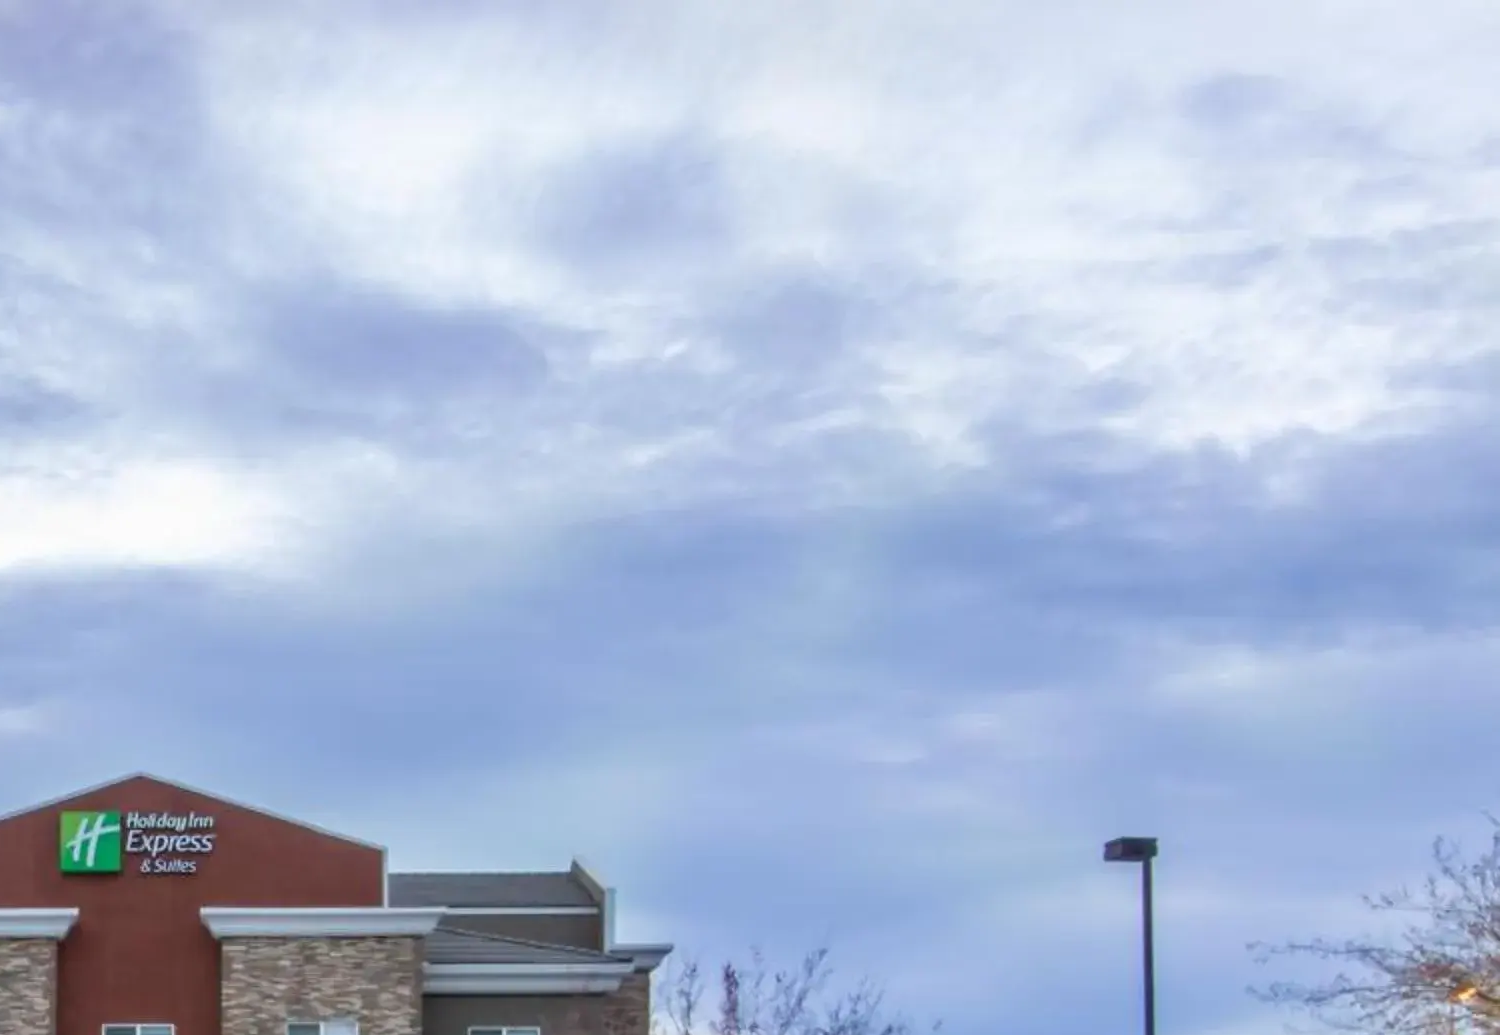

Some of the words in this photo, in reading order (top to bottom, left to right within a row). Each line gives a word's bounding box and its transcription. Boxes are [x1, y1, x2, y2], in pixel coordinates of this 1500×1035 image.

[126, 811, 187, 831] Holiday
[188, 811, 214, 829] Inn
[125, 829, 215, 857] Express
[139, 859, 151, 873] &
[153, 858, 197, 873] Suites
